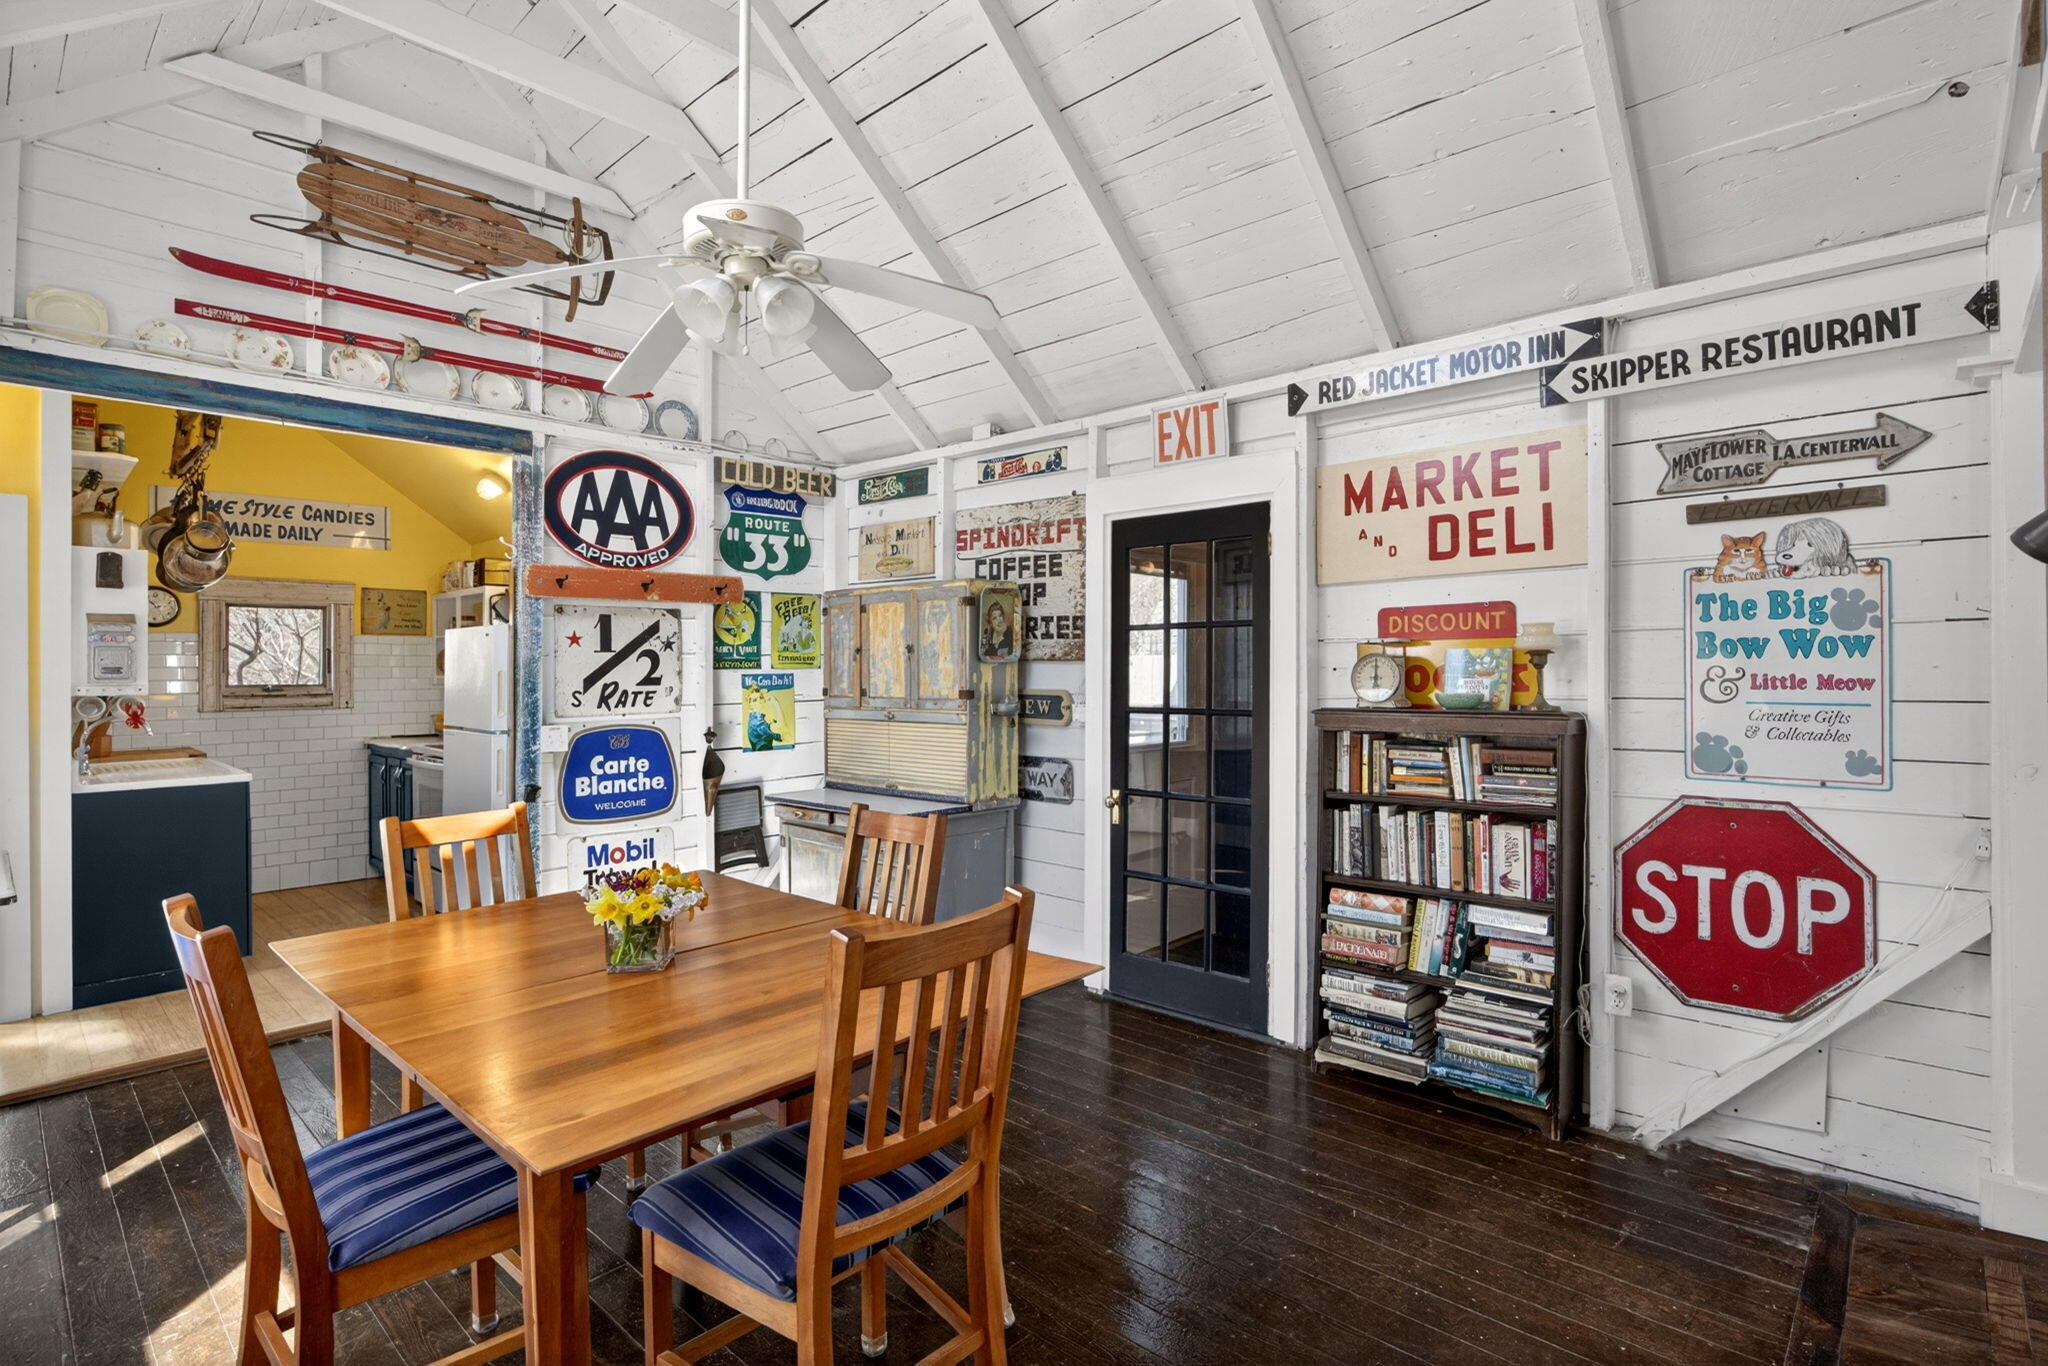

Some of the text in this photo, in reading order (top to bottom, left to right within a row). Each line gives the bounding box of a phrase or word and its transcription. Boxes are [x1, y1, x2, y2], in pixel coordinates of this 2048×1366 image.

[1571, 303, 1921, 394] SKIPPER RESTAURANT
[1318, 329, 1566, 405] RED JACKET MOTOR INN
[1157, 401, 1219, 463] EXIT
[1801, 433, 1899, 458] CENTERVALL
[1672, 438, 1767, 480] MAYFLOWER
[1693, 462, 1765, 483] COTTAGE
[722, 457, 832, 497] COLD BEER
[1344, 440, 1562, 517] MARKET
[239, 499, 295, 520] STYLE
[302, 504, 375, 526] CANDIES
[570, 469, 671, 551] AAA
[225, 521, 324, 542] MADE DAILY
[745, 516, 790, 533] ROUTE
[956, 517, 1087, 552] SPINDRIFT
[1428, 502, 1554, 561] DELI
[574, 543, 670, 568] APPROVED
[1358, 528, 1398, 558] AND
[975, 553, 1063, 581] COFFEE
[1018, 582, 1047, 606] OP
[1695, 589, 1829, 625] The Big
[1025, 615, 1086, 640] RIES
[1388, 611, 1506, 634] DISCOUNT
[1695, 628, 1875, 659] Bow Wow
[571, 690, 582, 708] S
[596, 681, 658, 712] RATE
[1700, 665, 1876, 704] & Little Meow
[1025, 699, 1052, 715] EW
[1748, 709, 1852, 727] Creative Gifts
[1766, 726, 1852, 743] Collectables
[590, 754, 650, 776] Carte
[575, 772, 666, 797] Blanche
[1027, 770, 1058, 789] WAY
[594, 799, 647, 811] WELCOME
[587, 838, 654, 868] Mobil
[1631, 859, 1851, 956] STOP
